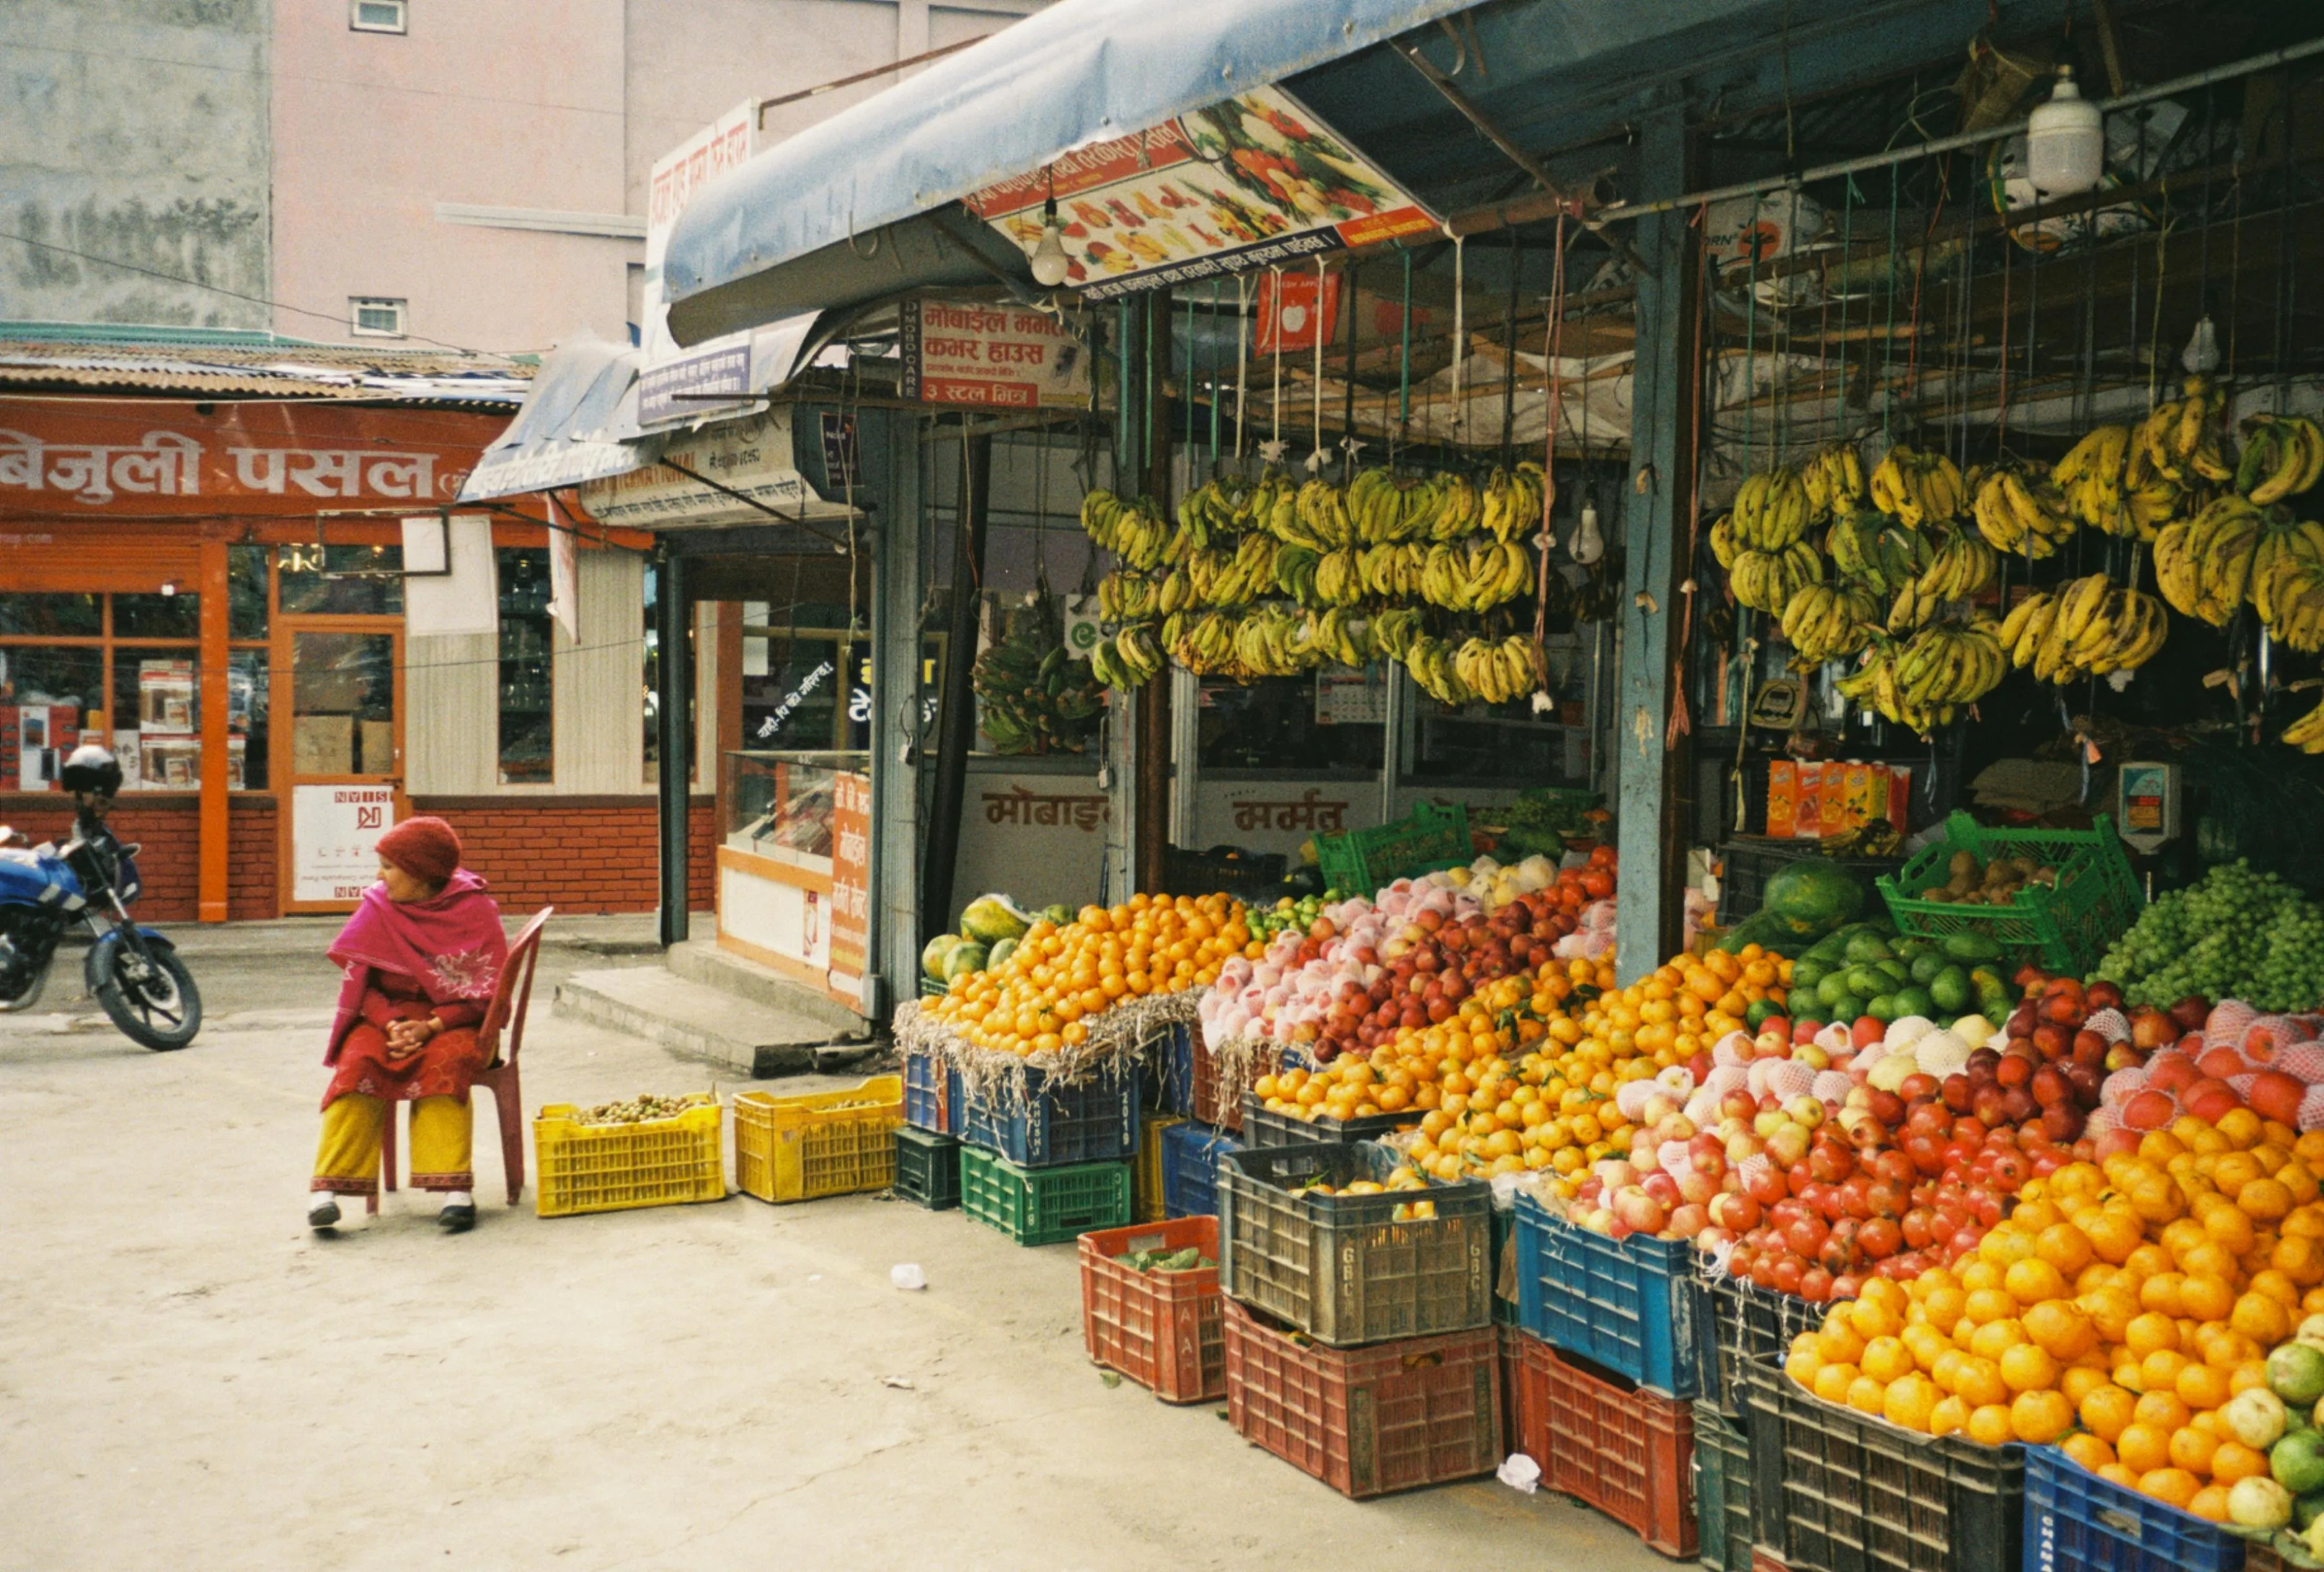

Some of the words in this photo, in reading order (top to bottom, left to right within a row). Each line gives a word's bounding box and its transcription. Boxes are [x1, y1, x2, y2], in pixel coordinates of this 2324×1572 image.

[924, 337, 981, 361] कभर
[988, 341, 1044, 364] हाउस
[227, 446, 440, 499] पसल
[981, 784, 1110, 832] मोबाइ
[1233, 788, 1349, 832] मर्मत
